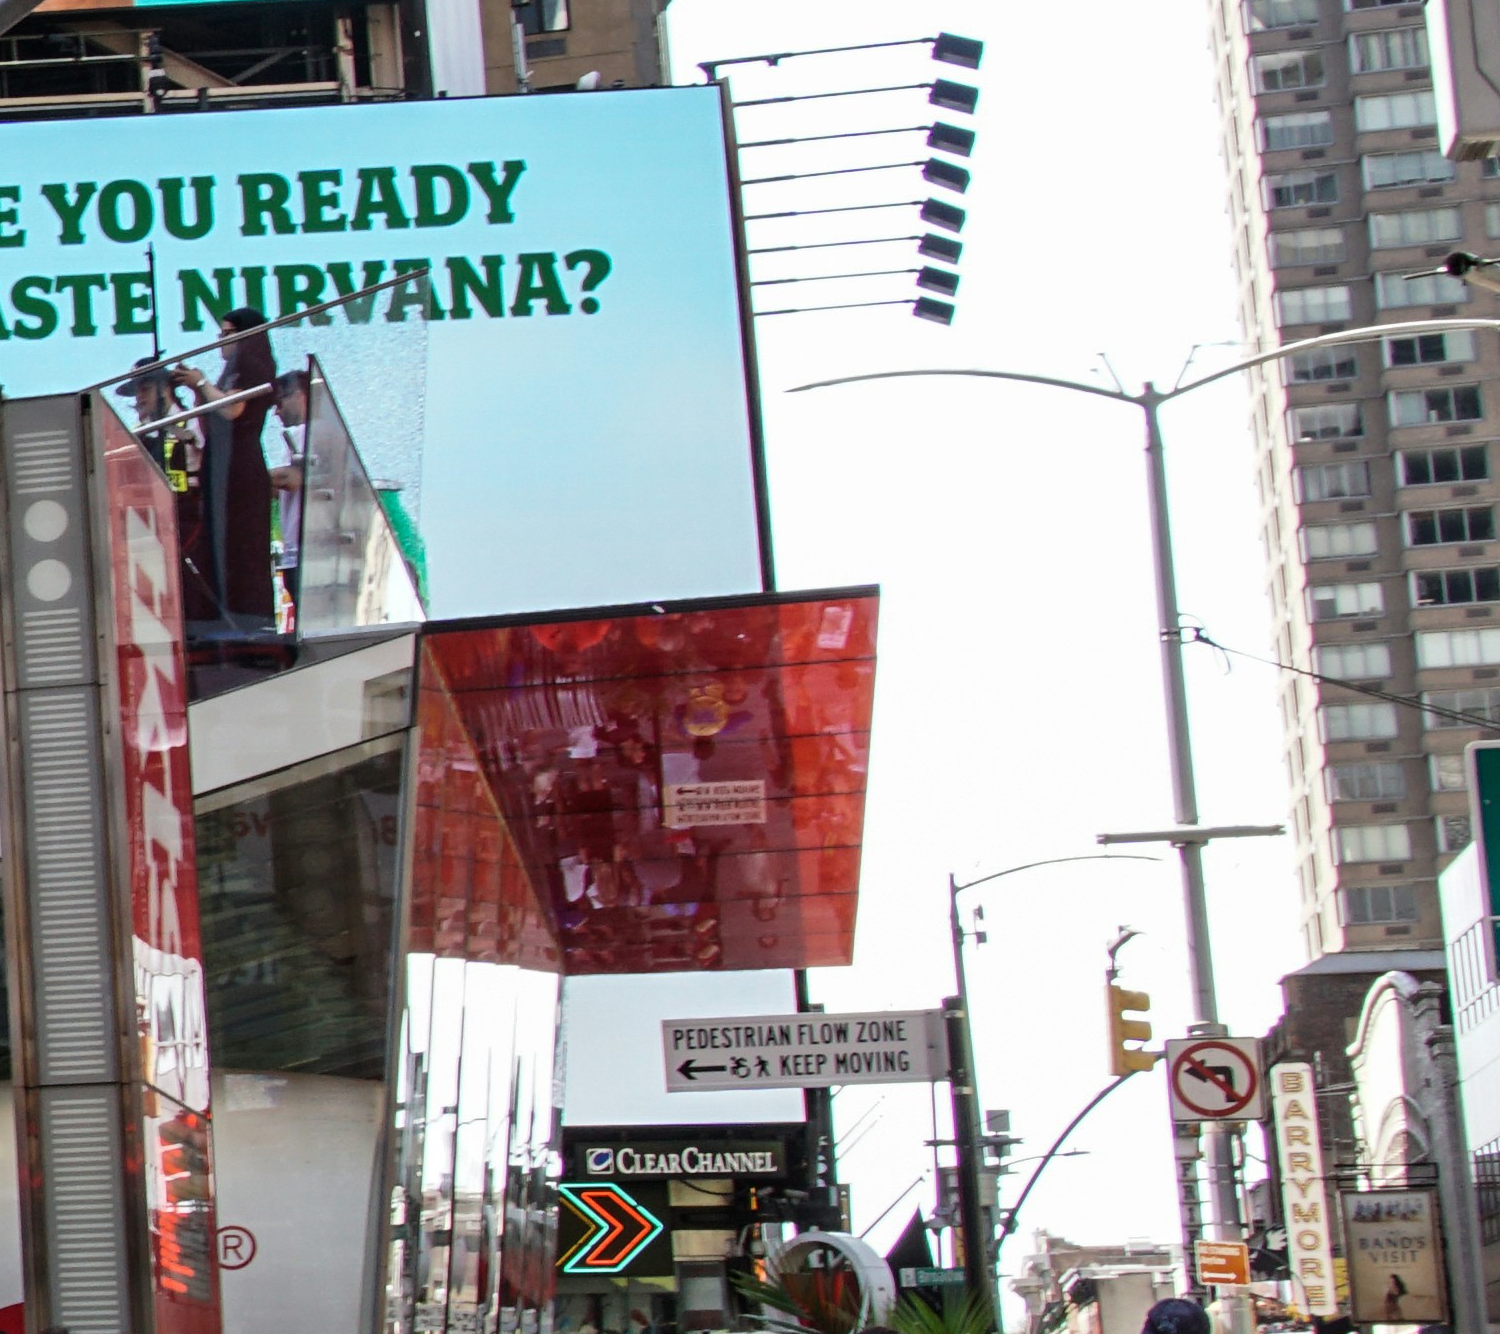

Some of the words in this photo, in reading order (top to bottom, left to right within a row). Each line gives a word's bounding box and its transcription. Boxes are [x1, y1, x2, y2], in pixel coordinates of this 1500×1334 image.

[40, 174, 217, 246] YOU
[237, 159, 528, 237] READY
[177, 248, 612, 334] NIRVANA?
[673, 1025, 791, 1051] PEDESTRIAN
[798, 1022, 849, 1046] FLOW
[856, 1020, 907, 1043] ZONE
[780, 1053, 827, 1076] KEEP
[835, 1051, 910, 1074] MOVING
[1279, 1071, 1328, 1308] BARRYMORE
